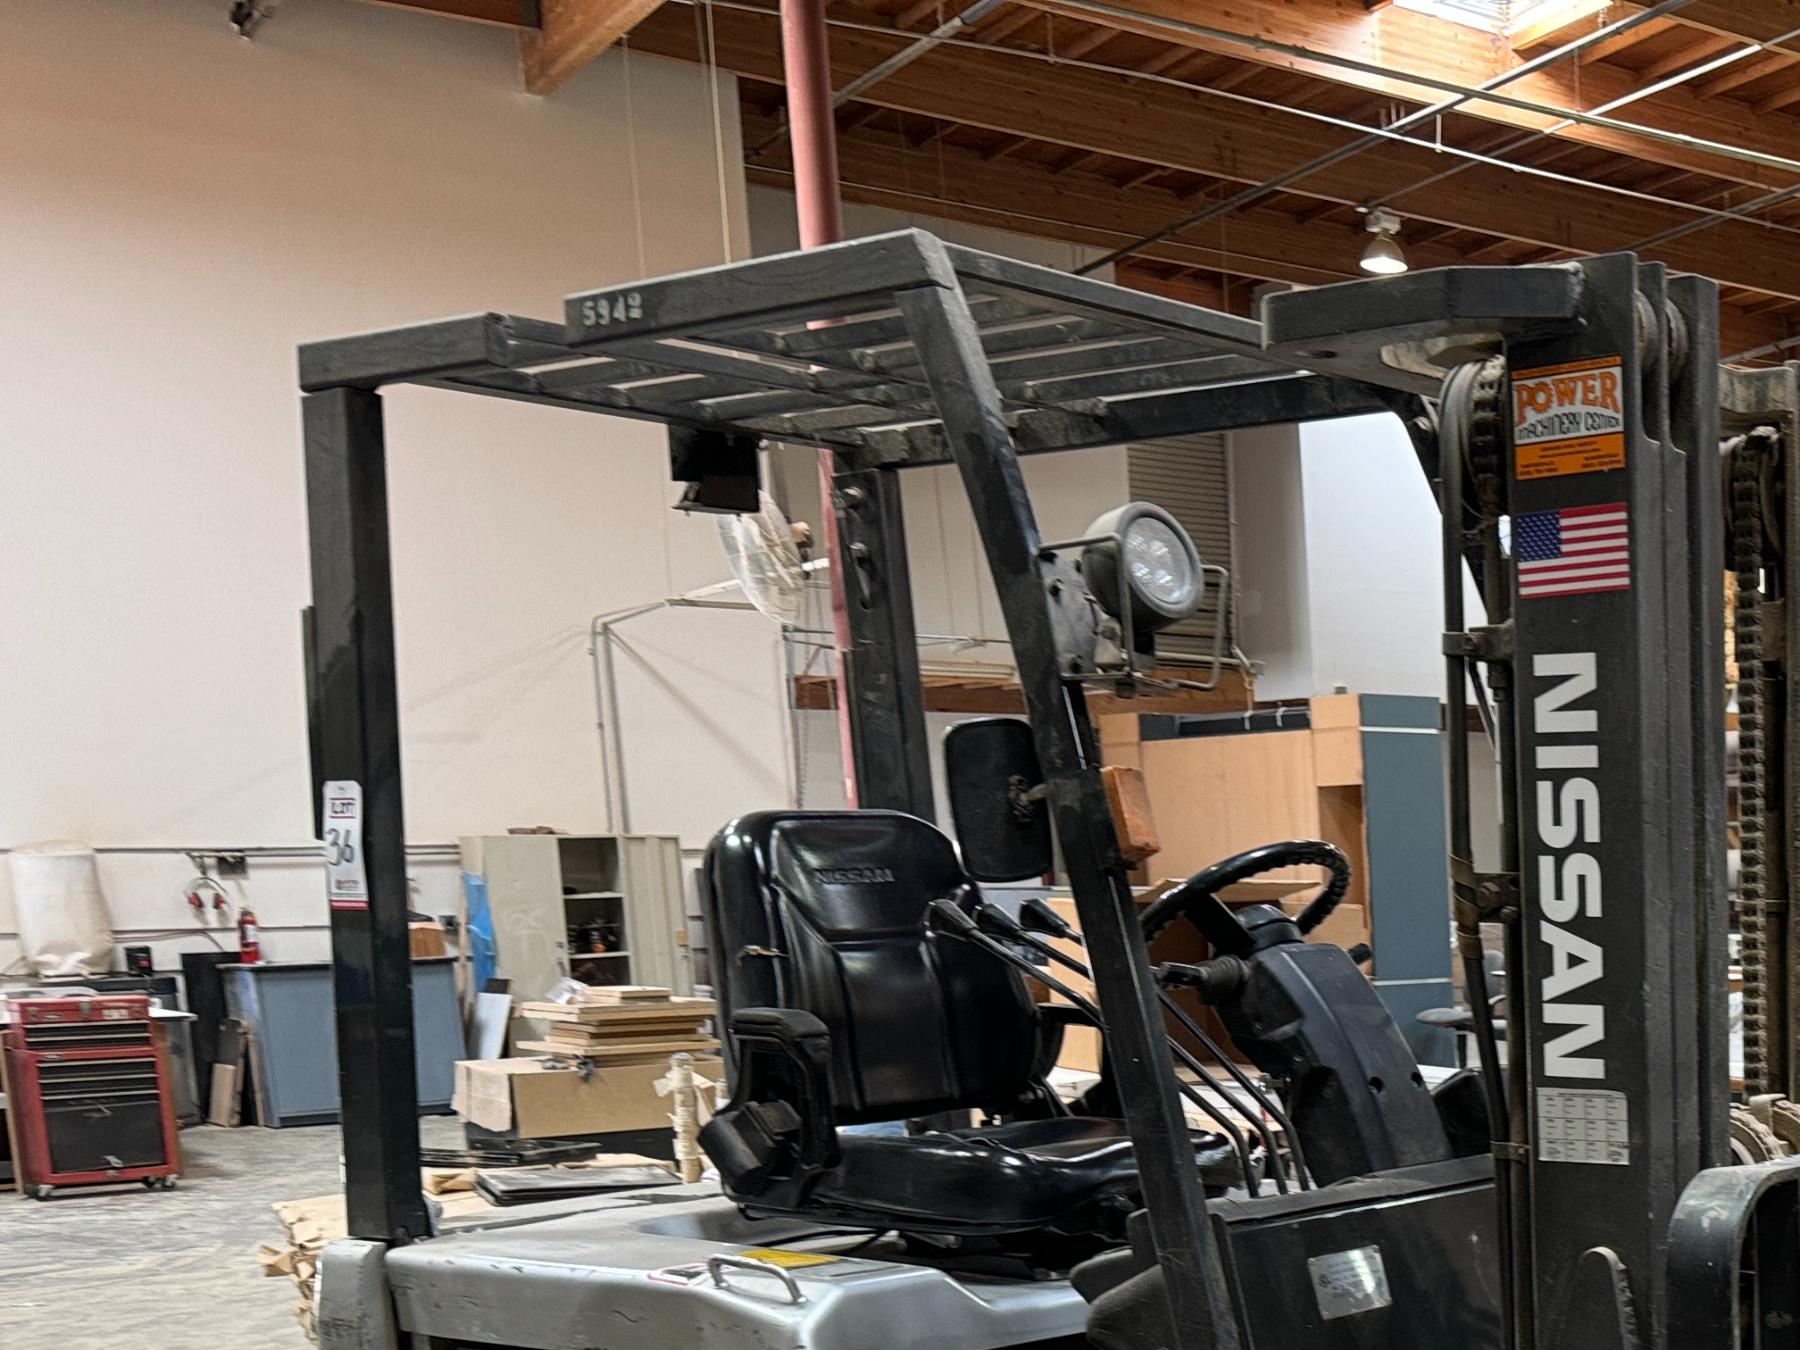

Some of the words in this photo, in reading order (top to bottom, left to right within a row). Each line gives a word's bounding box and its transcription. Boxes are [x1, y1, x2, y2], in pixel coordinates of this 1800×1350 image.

[1514, 370, 1621, 425] POWER
[326, 828, 354, 866] 36
[1532, 652, 1605, 1079] NISSAN
